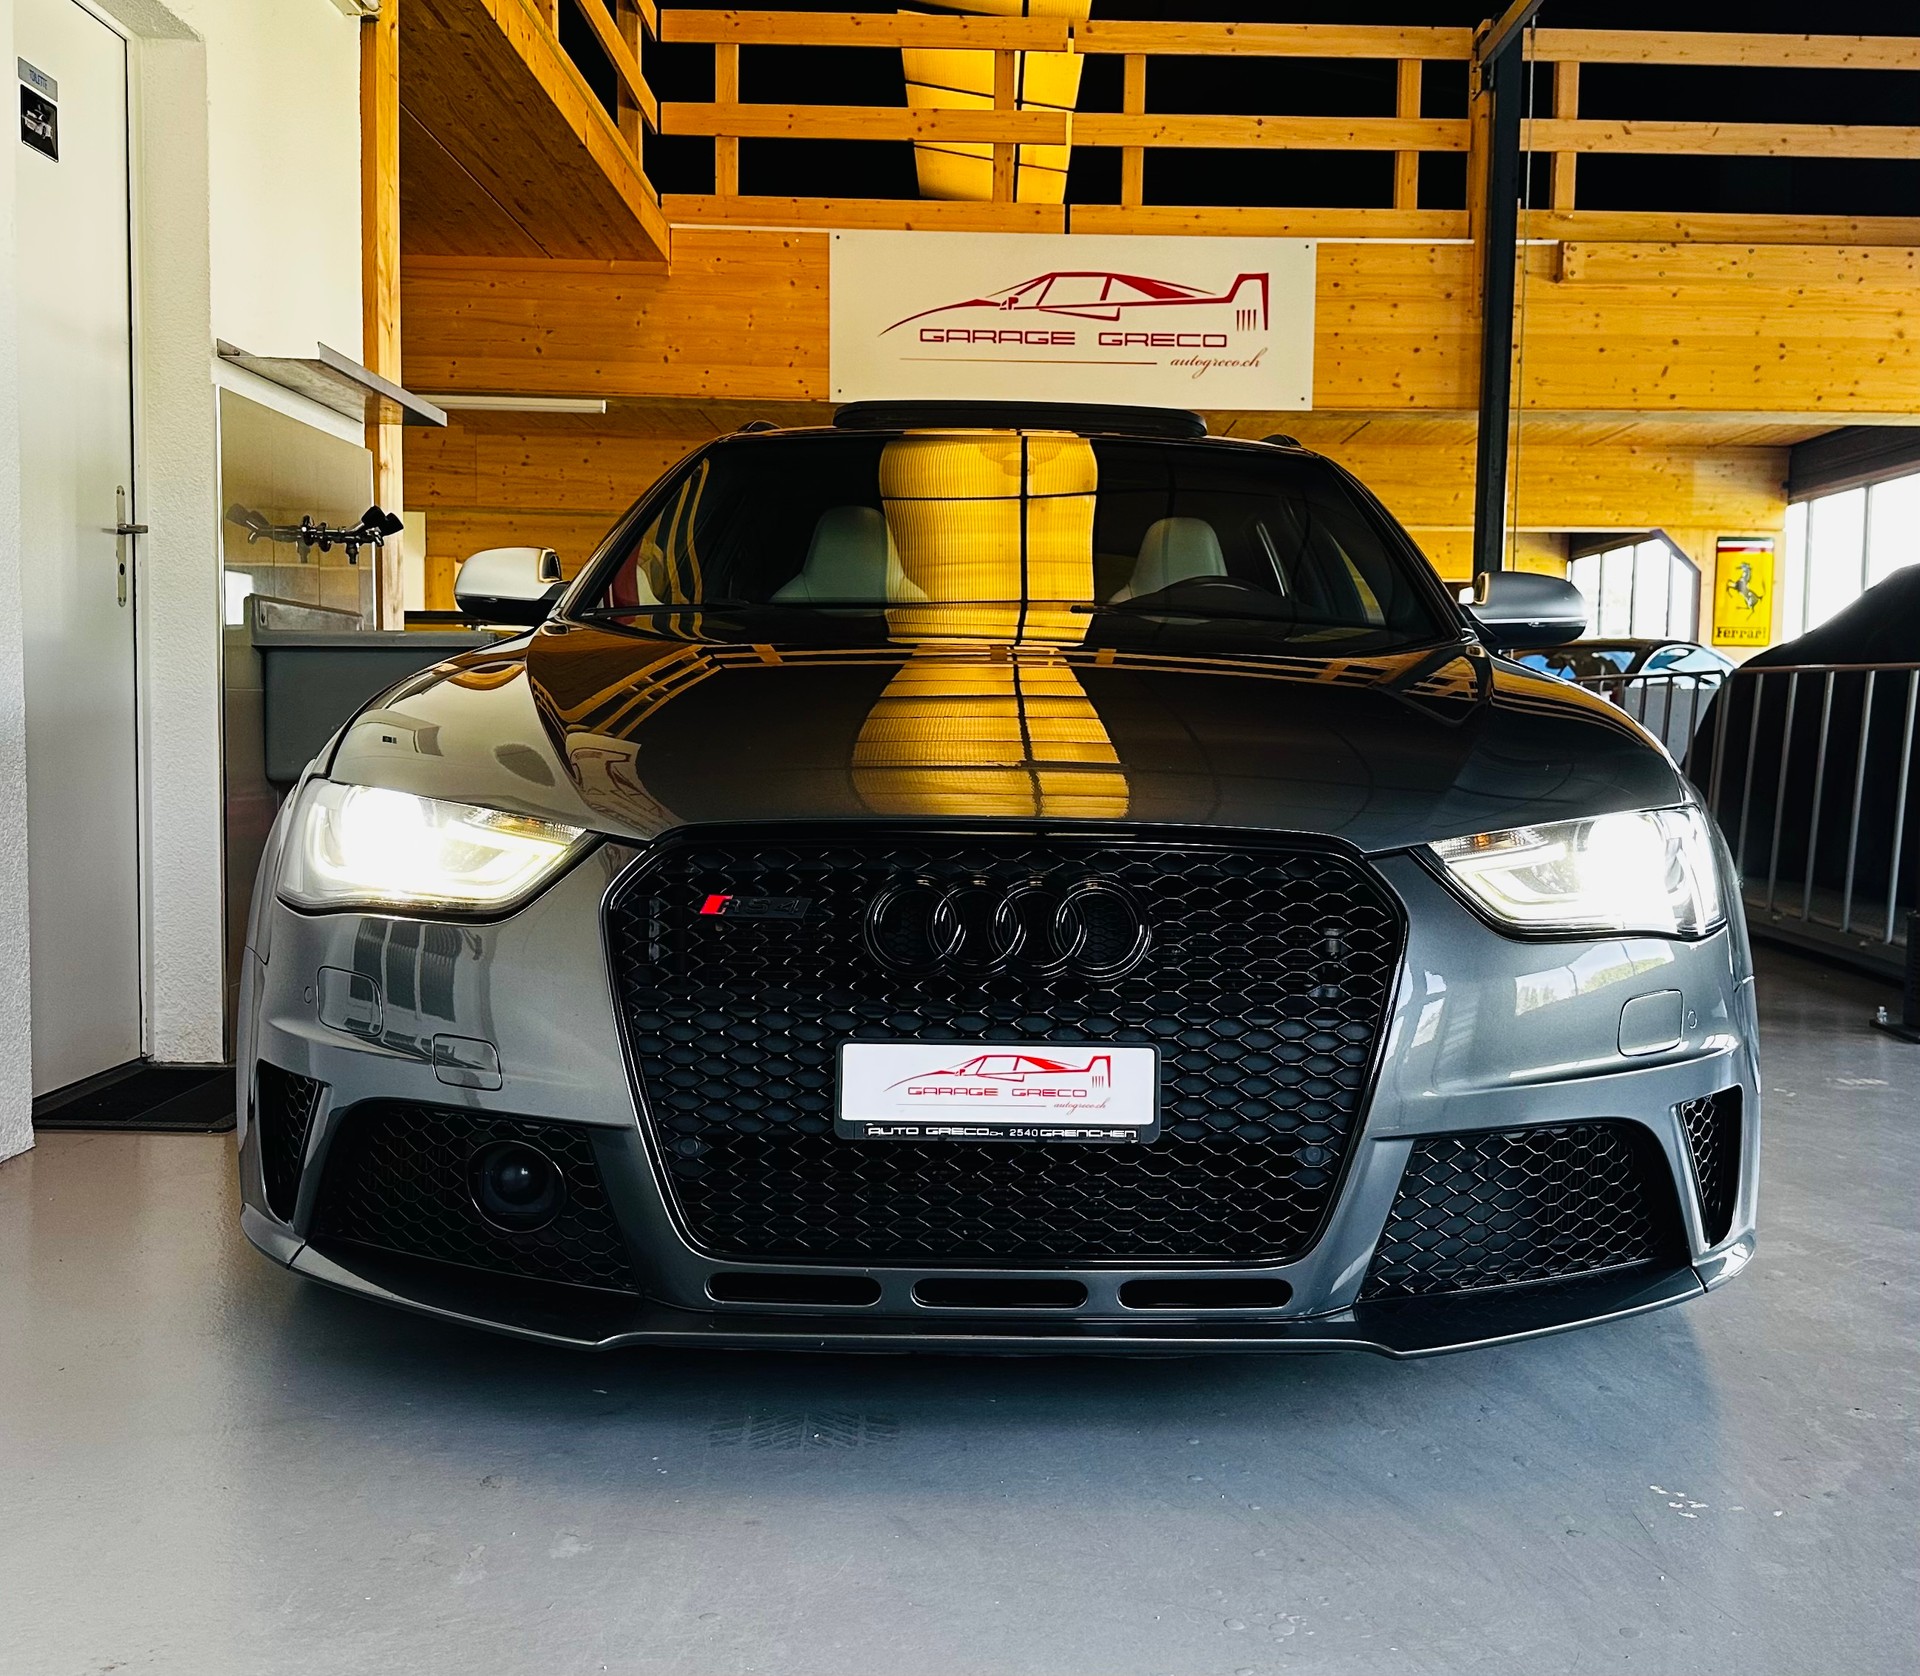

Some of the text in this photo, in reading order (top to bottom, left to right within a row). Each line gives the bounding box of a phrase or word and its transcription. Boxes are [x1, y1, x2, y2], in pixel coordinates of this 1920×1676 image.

[919, 328, 1227, 348] GARAGE GRECO
[1716, 626, 1766, 639] Ferrari
[907, 1086, 1087, 1098] GARAGE GRECO
[867, 1127, 919, 1136] AUTO
[1009, 1128, 1038, 1138] 2540
[1039, 1129, 1137, 1139] GRENCHEN
